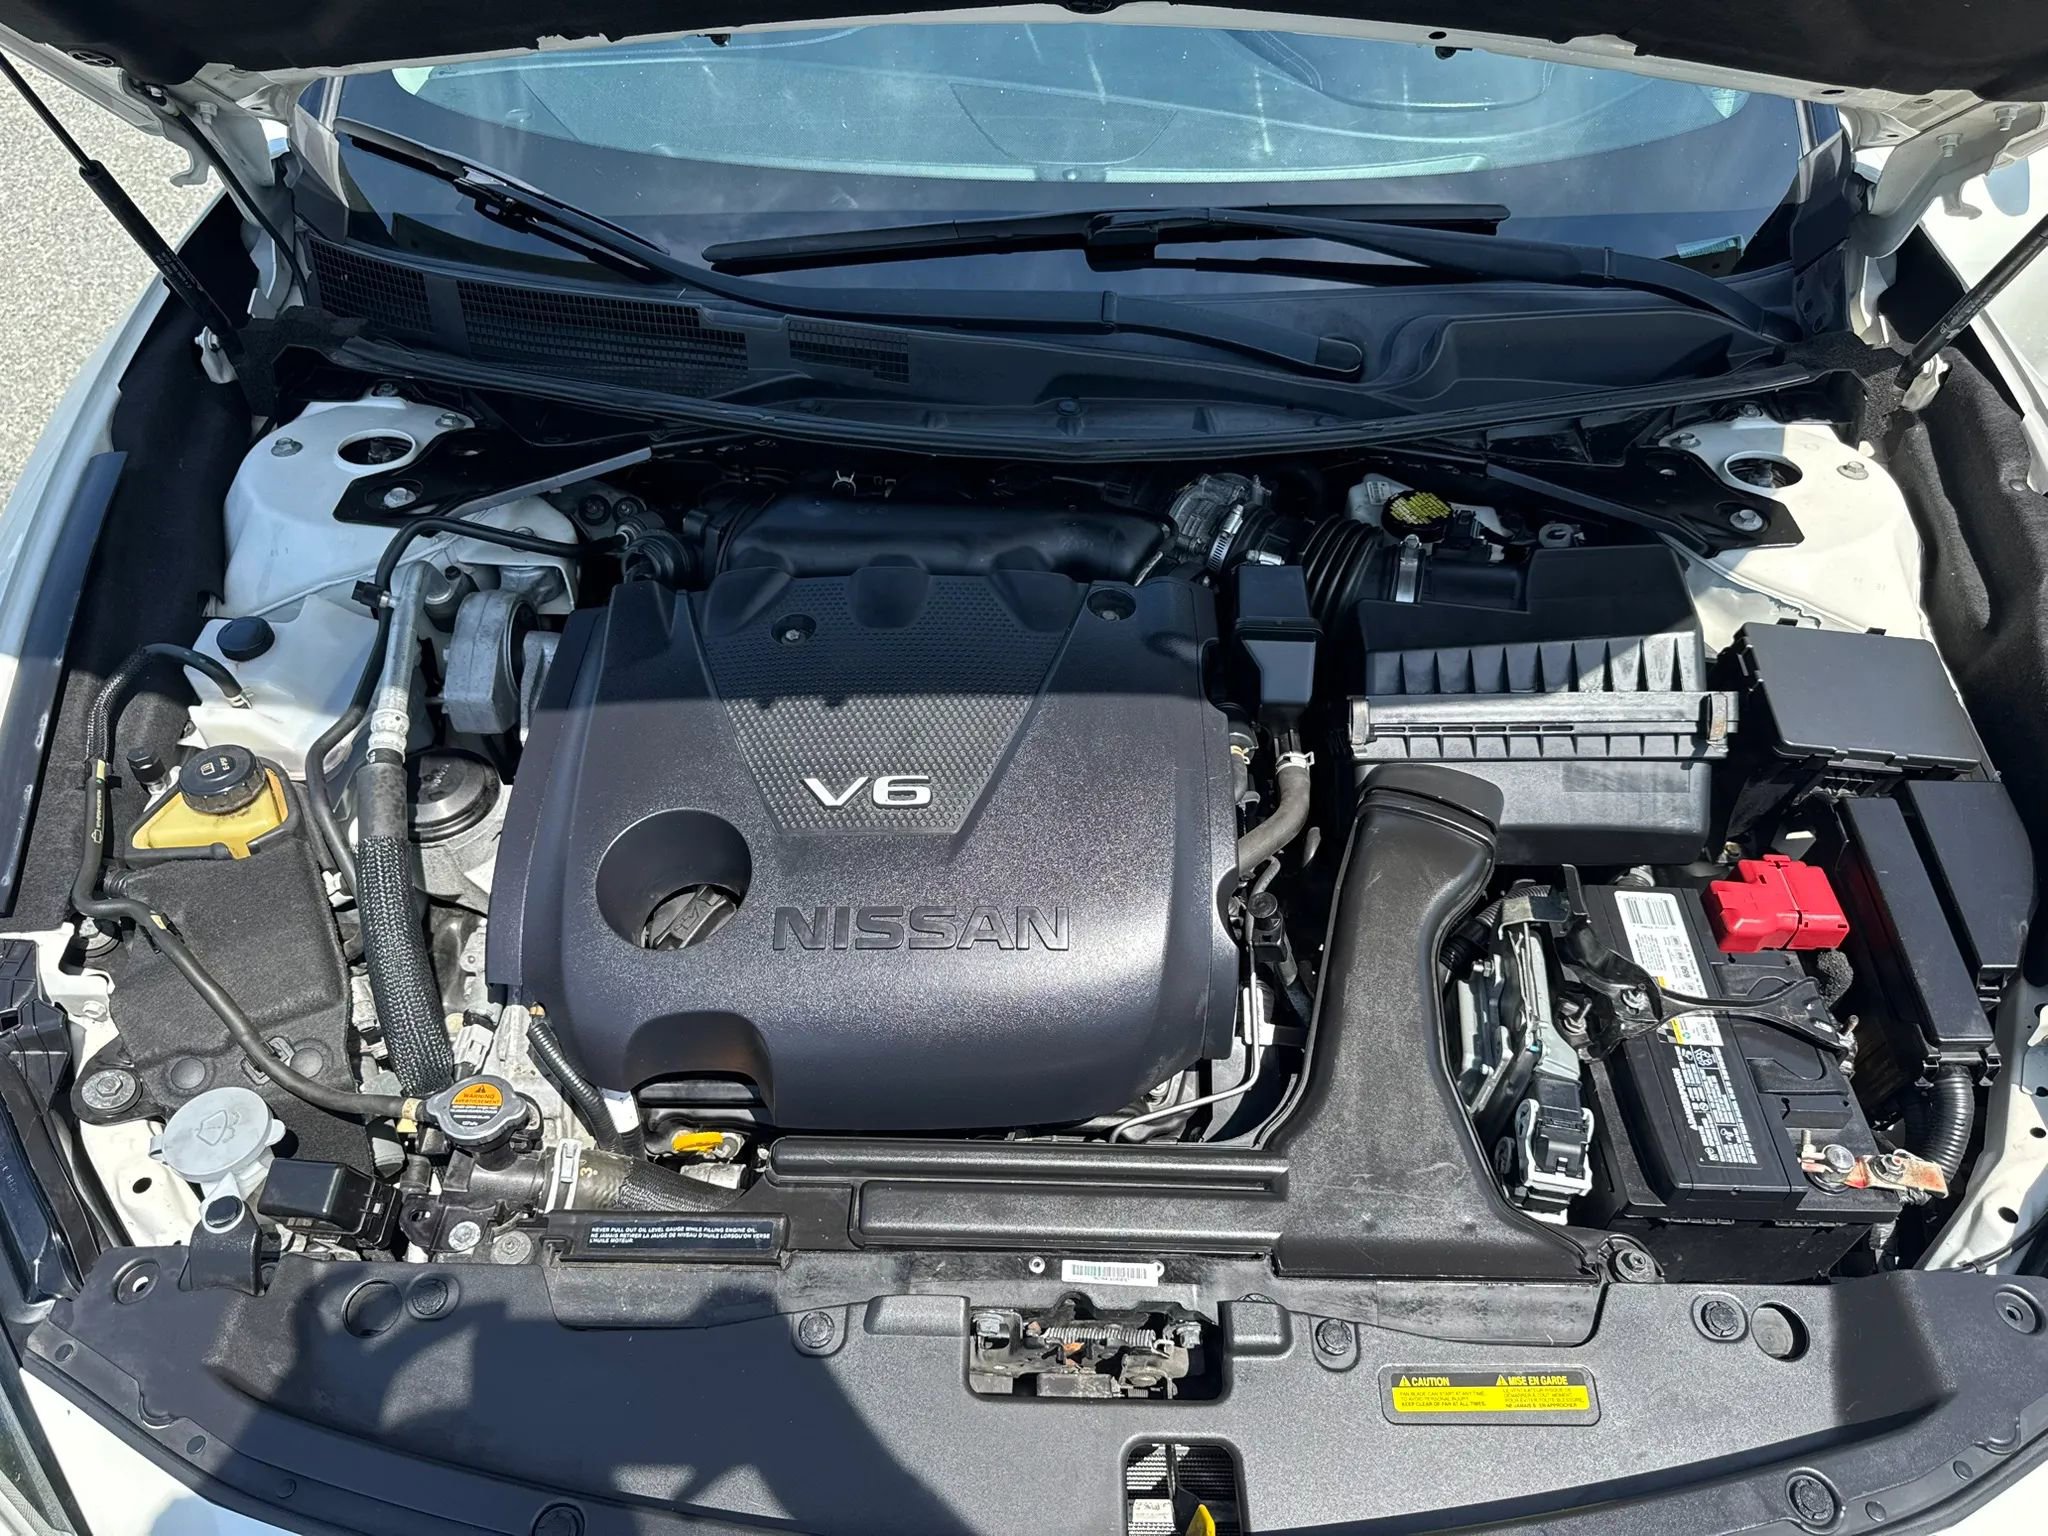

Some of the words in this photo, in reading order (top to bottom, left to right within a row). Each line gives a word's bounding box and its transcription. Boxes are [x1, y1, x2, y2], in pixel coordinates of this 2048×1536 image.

[802, 775, 933, 808] V6
[772, 906, 1070, 950] NISSAN
[1411, 1376, 1450, 1387] CAUTION
[1507, 1375, 1527, 1386] MISE
[1528, 1375, 1540, 1386] EN
[1540, 1375, 1568, 1386] GARDE
